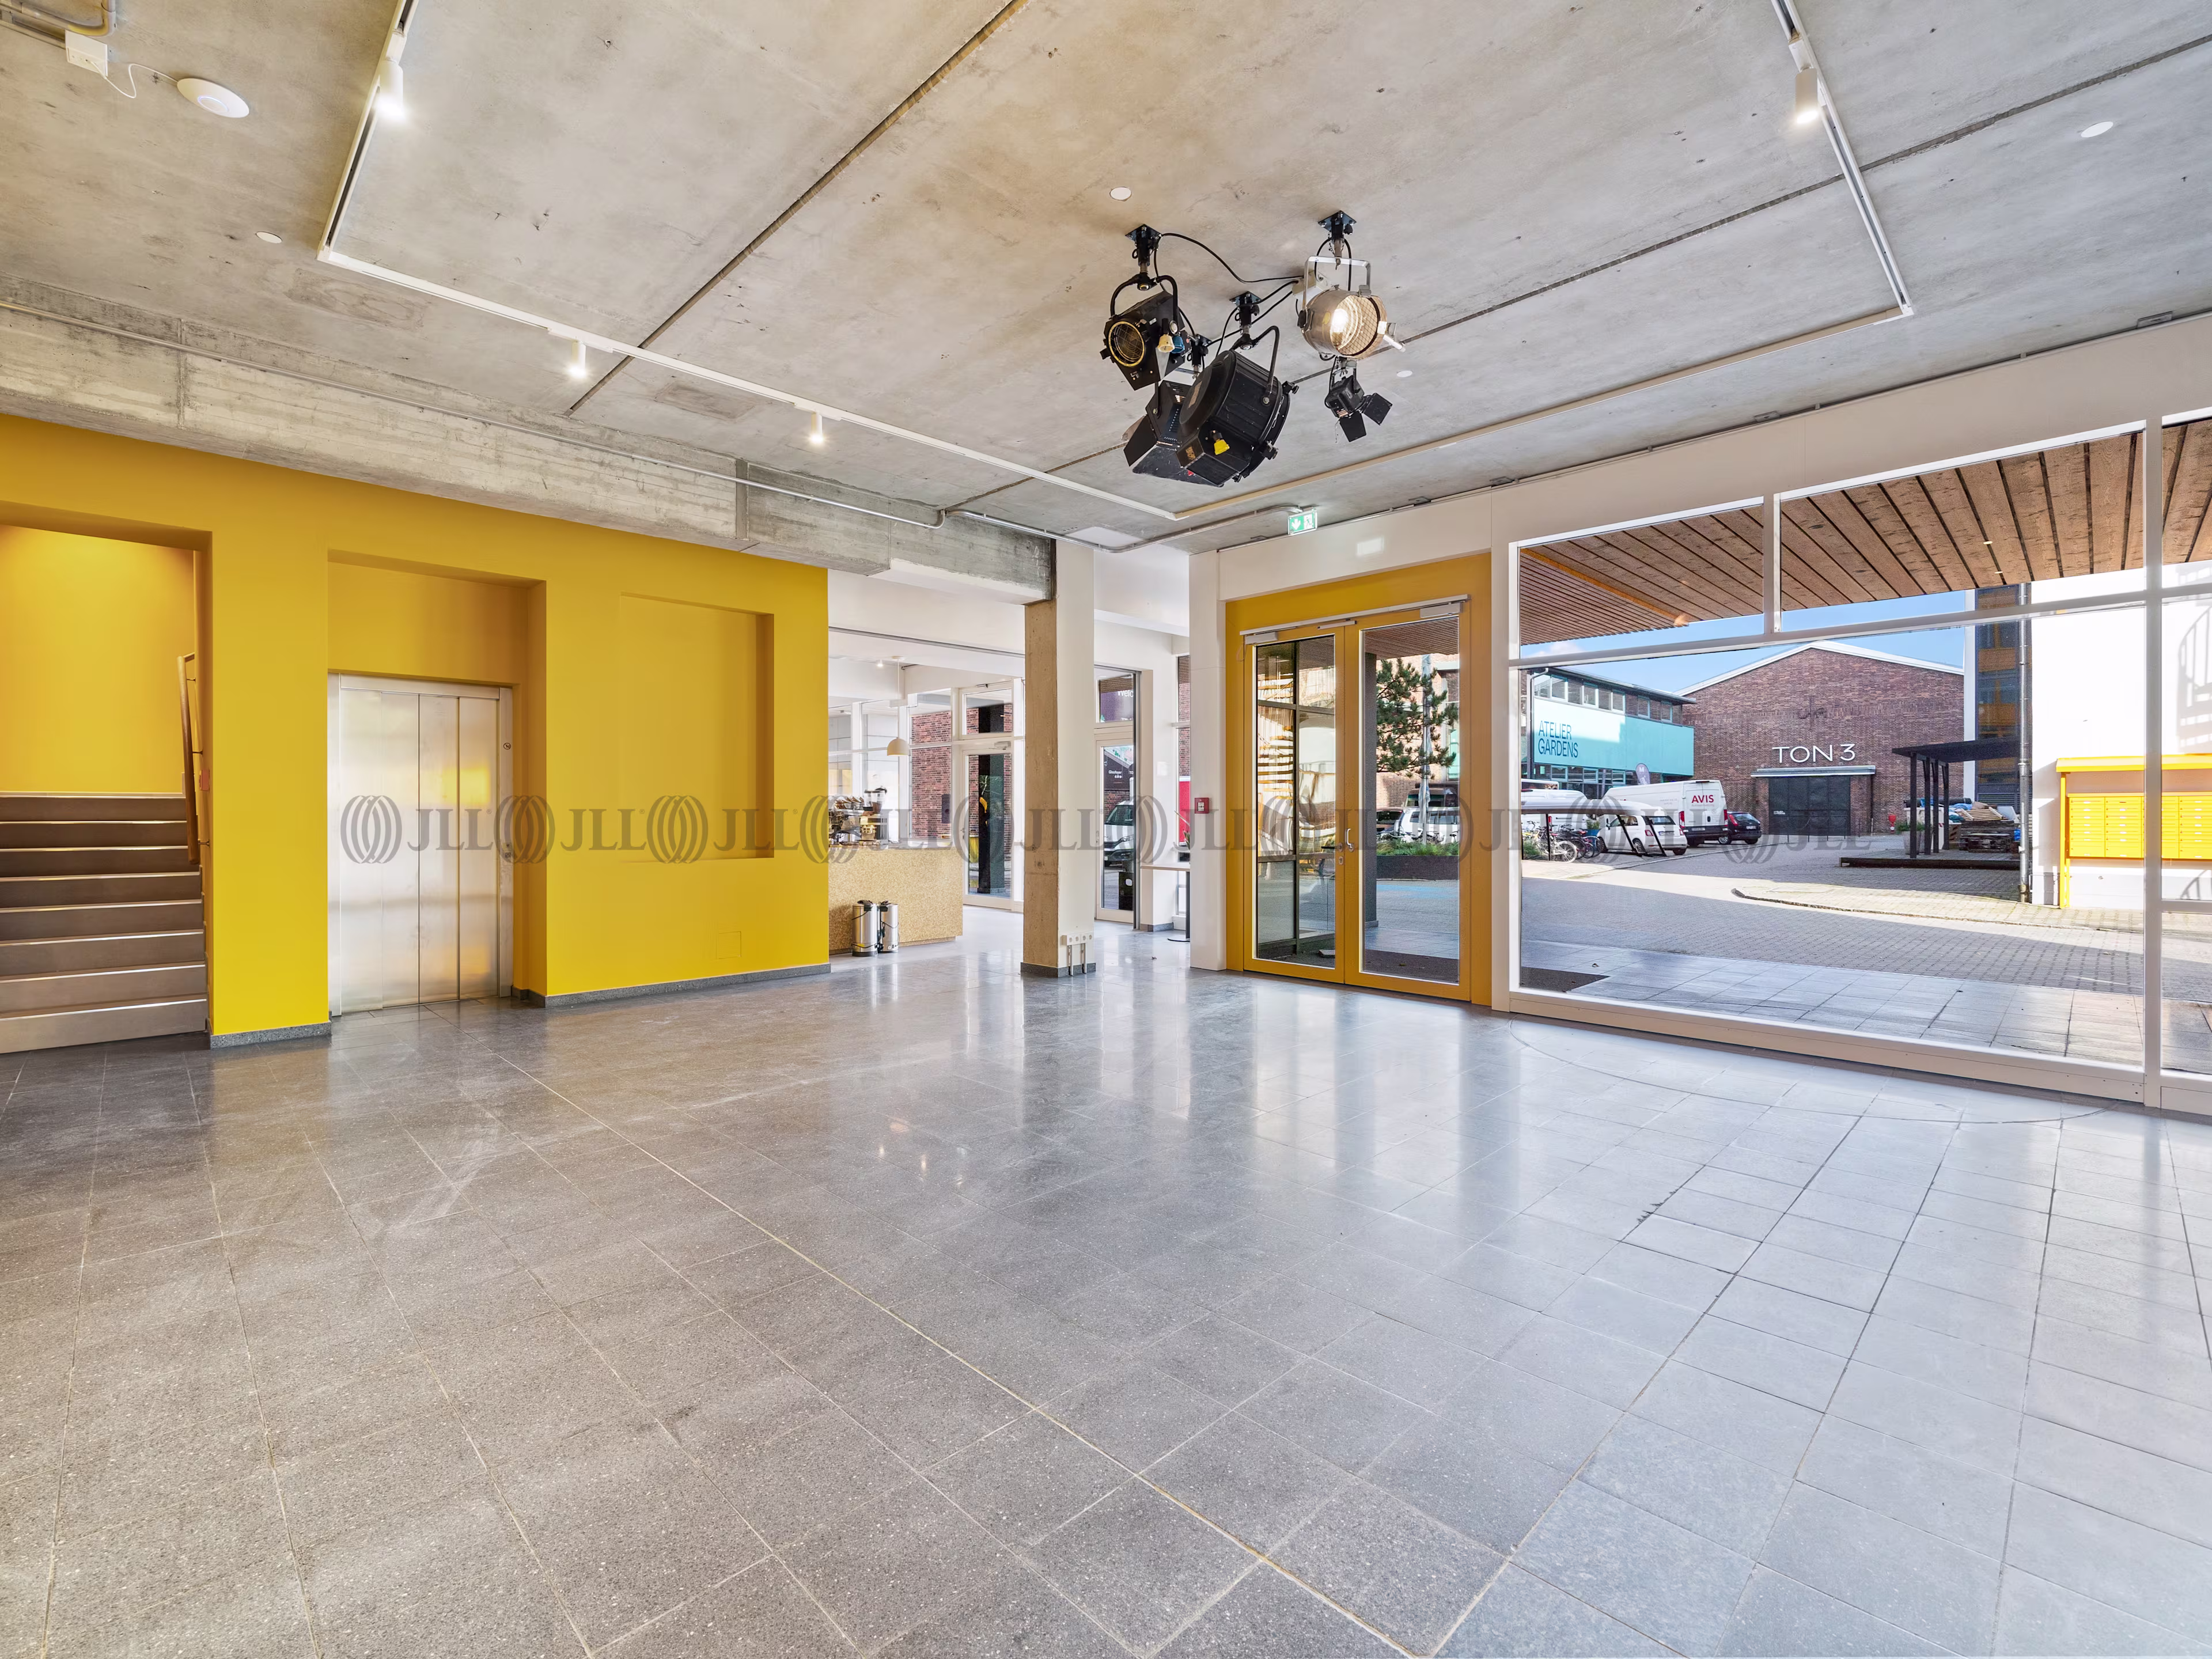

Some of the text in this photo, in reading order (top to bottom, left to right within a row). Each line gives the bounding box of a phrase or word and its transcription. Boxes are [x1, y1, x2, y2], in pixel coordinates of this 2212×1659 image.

[1539, 720, 1572, 740] ATELIER
[1538, 738, 1578, 758] GARDENS
[1772, 744, 1855, 763] TON 3
[1691, 795, 1714, 803] AVIS
